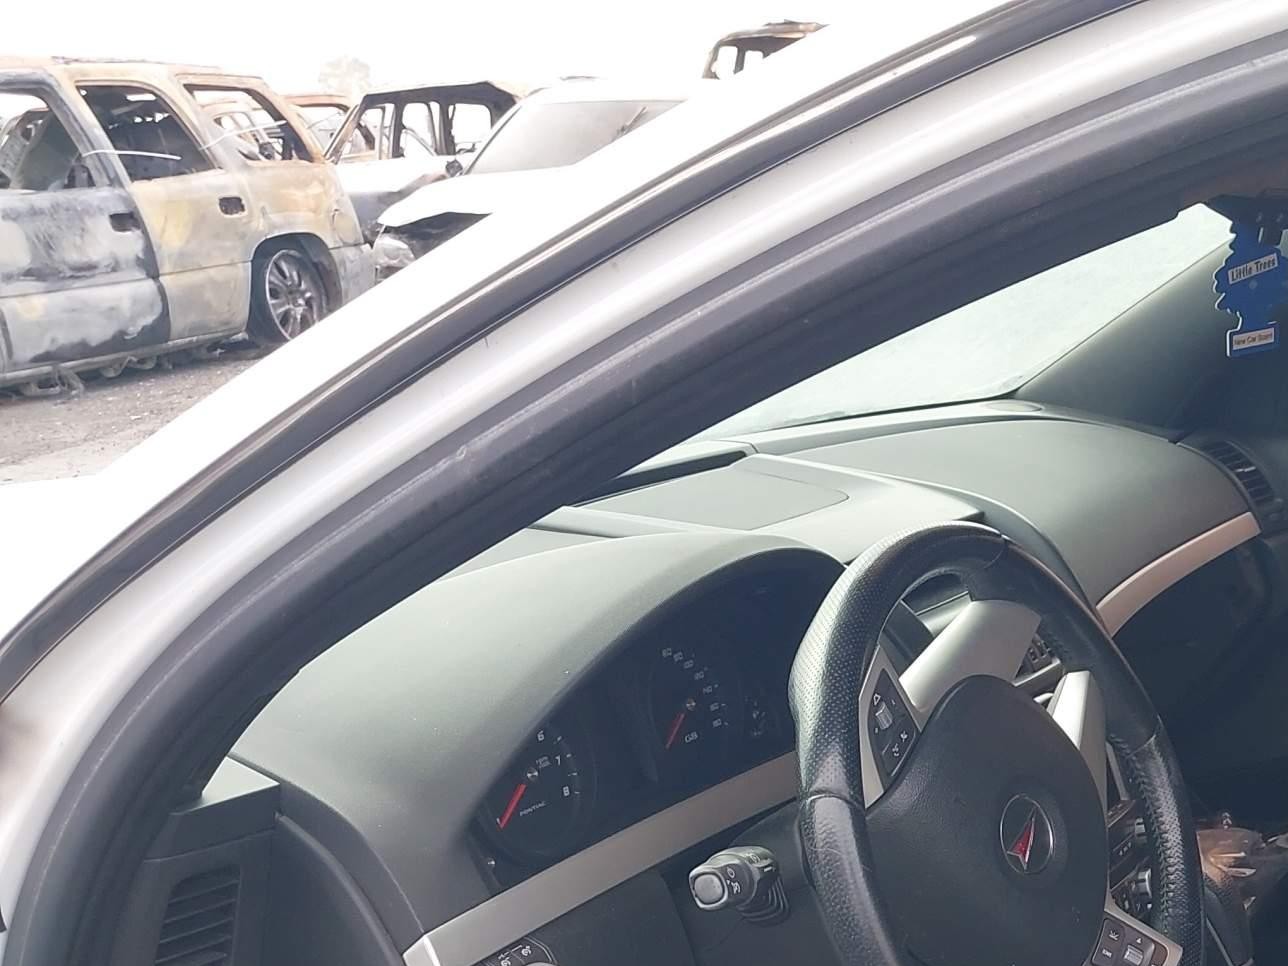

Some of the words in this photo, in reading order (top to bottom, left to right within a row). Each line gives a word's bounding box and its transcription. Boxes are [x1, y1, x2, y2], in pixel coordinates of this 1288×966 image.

[1231, 264, 1253, 282] Little
[1254, 257, 1276, 273] Trees
[537, 730, 545, 741] 6
[684, 731, 698, 743] G8
[555, 755, 561, 766] 7
[562, 786, 570, 797] 8
[519, 801, 546, 816] PONTIAC
